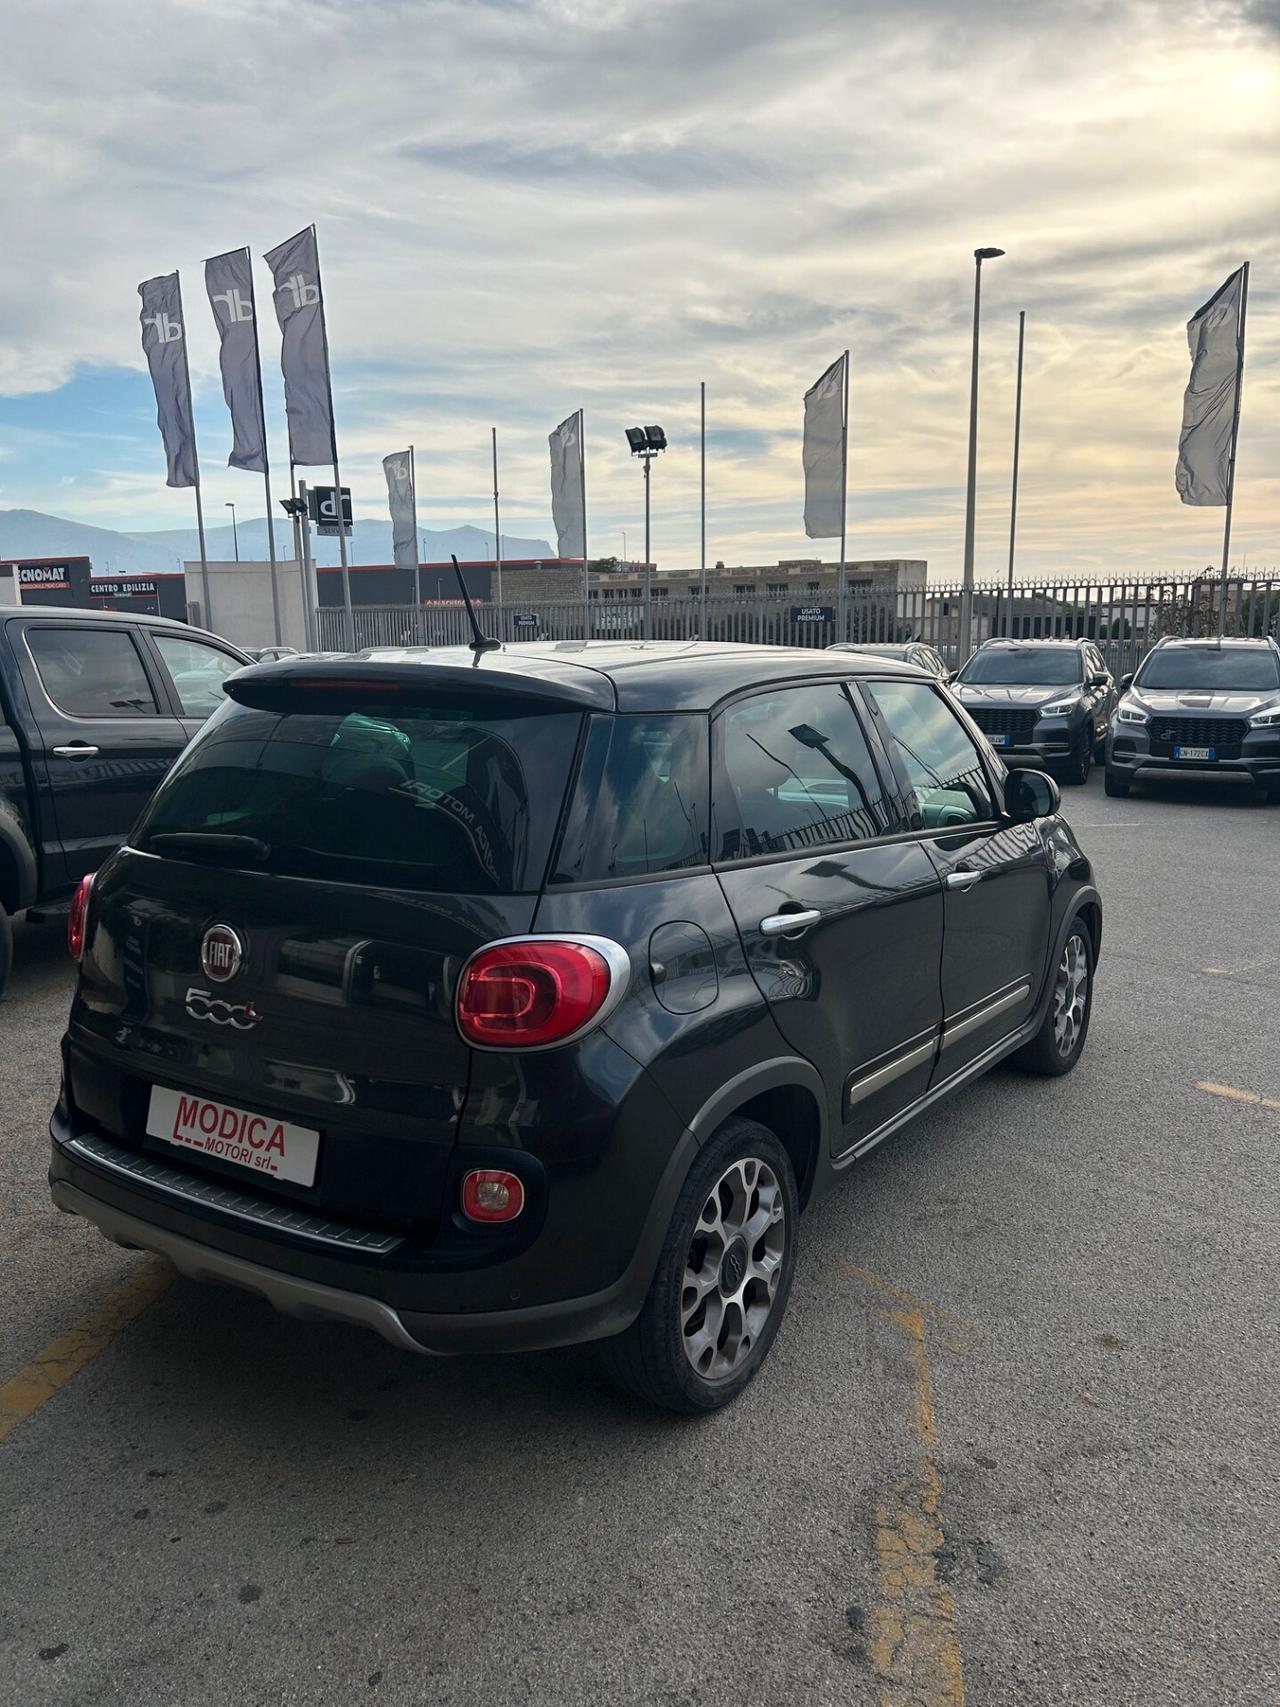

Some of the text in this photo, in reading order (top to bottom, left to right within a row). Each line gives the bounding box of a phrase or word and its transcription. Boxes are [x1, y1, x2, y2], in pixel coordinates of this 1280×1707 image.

[91, 582, 155, 593] CENTRO EDILIZIA
[209, 942, 232, 968] FIAT
[172, 1096, 286, 1157] MODICA
[204, 1137, 272, 1171] MOTORI srl
